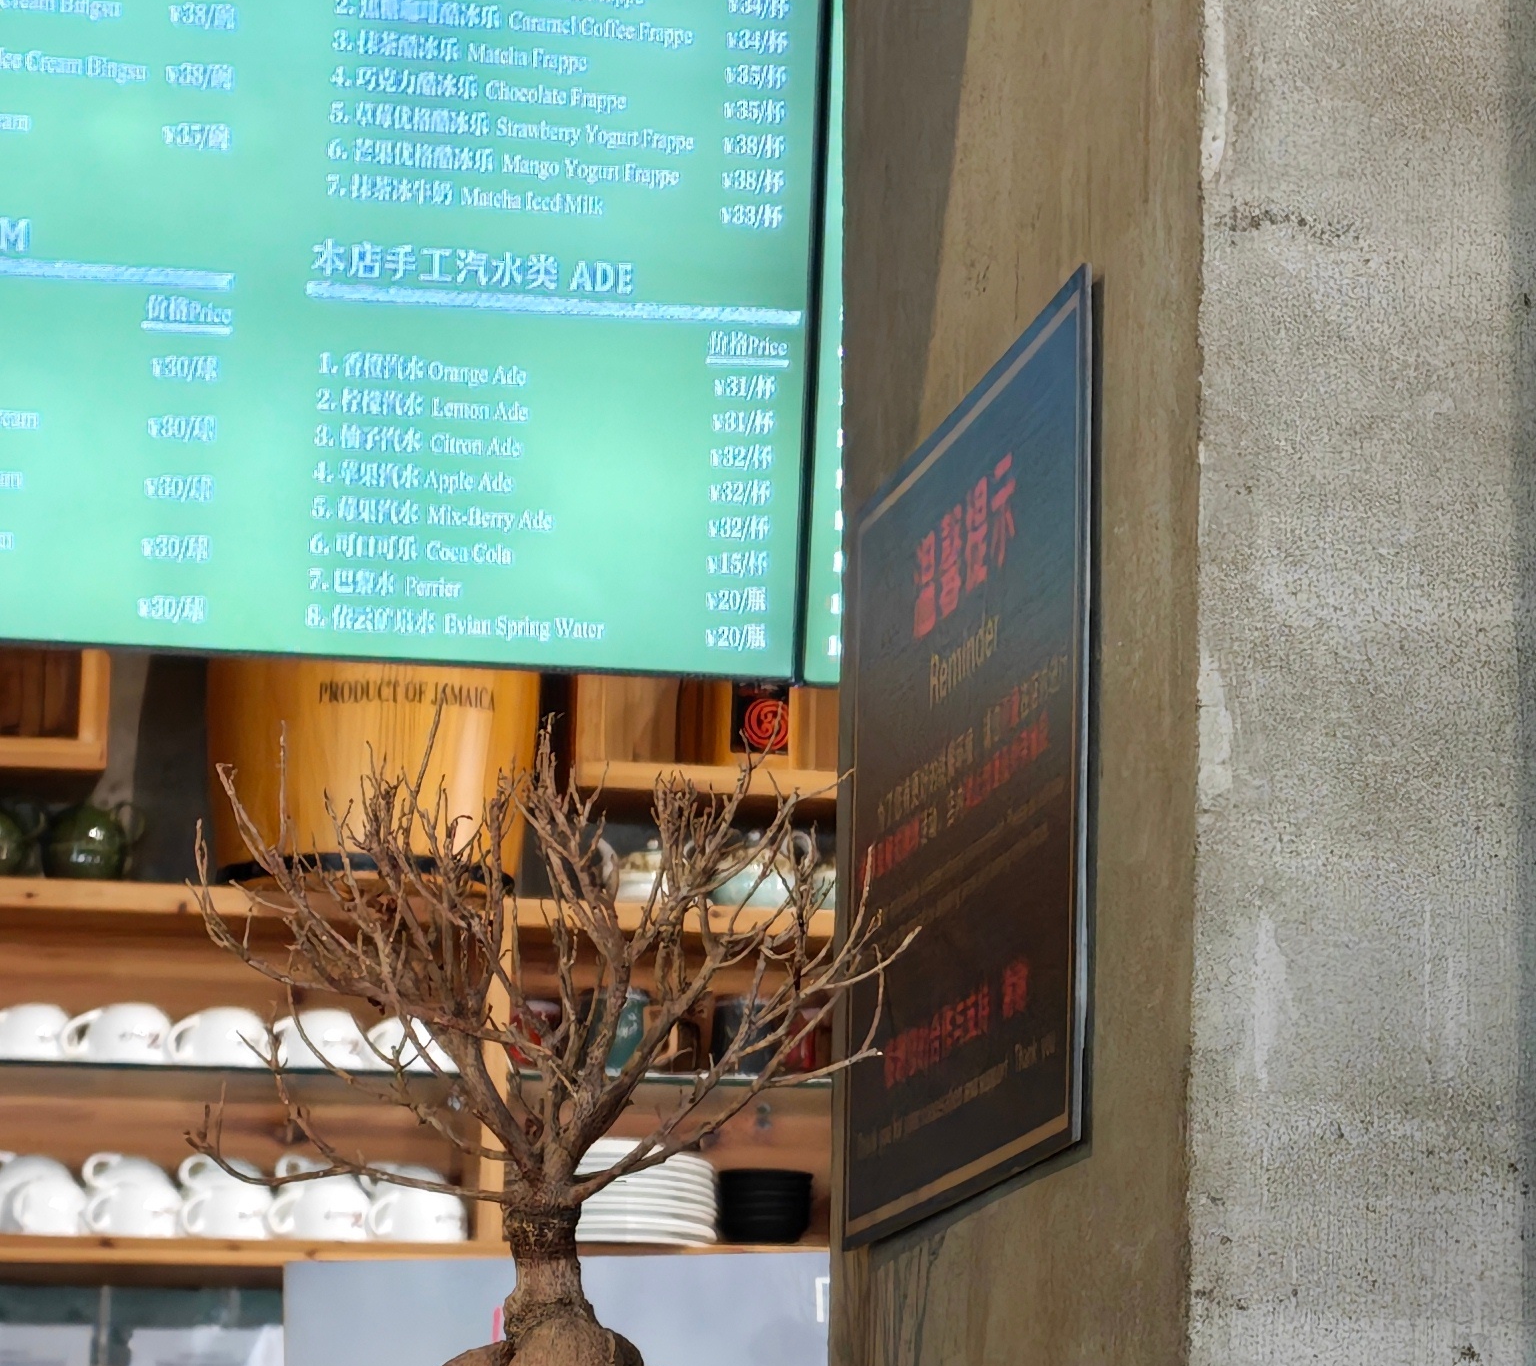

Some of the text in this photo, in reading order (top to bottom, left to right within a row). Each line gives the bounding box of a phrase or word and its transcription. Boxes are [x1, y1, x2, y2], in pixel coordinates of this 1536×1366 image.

[311, 238, 635, 296] 本店手工汽水类 ADE
[929, 610, 1000, 710] Reminder
[318, 678, 496, 711] PRODUCT OF JAMAICA
